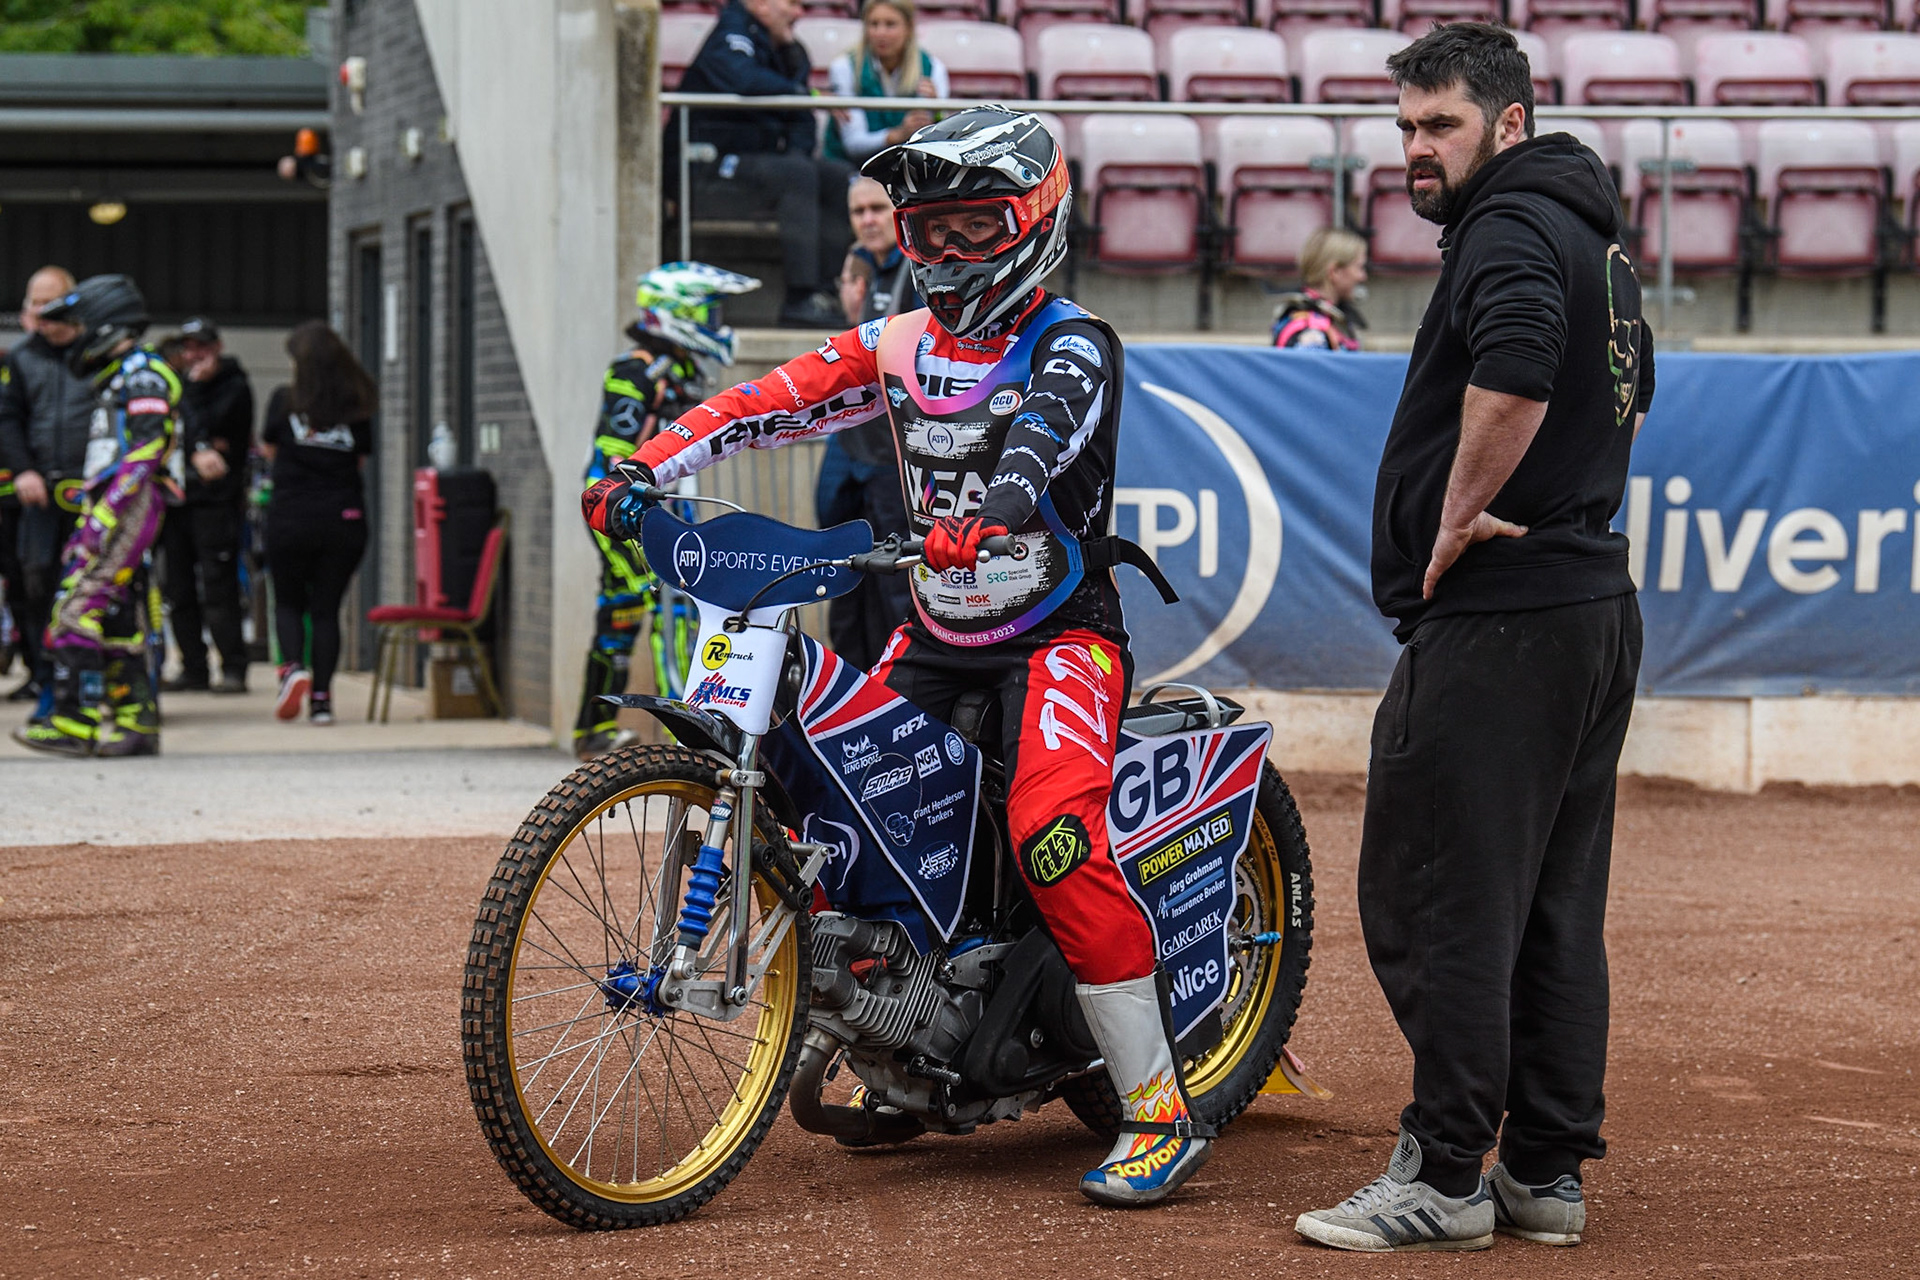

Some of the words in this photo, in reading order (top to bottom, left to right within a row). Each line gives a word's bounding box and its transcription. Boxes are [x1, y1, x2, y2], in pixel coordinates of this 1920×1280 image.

[992, 395, 1014, 406] ACU
[931, 434, 949, 445] ATPI
[678, 550, 700, 567] ATPI
[709, 550, 767, 571] SPORTS
[770, 553, 838, 577] EVENTS
[949, 571, 977, 585] GB
[986, 571, 1009, 584] SRG
[965, 594, 991, 604] NGK
[931, 624, 990, 644] MANCHESTER
[990, 624, 1016, 640] 2023
[706, 641, 754, 661] Rentruck
[710, 696, 747, 708] Racing
[891, 712, 929, 744] RFX
[918, 747, 939, 768] NGK
[1109, 738, 1191, 833] GB
[931, 789, 966, 811] Henderson
[926, 808, 954, 826] Tankers
[1141, 843, 1186, 880] POWER
[1183, 817, 1230, 855] MAXED
[1168, 880, 1186, 896] Jörg
[1184, 855, 1223, 885] Grohmann
[1171, 892, 1204, 919] Insurance
[1203, 878, 1227, 899] Broker
[1290, 871, 1302, 928] ANLAS
[1161, 908, 1223, 957] GARCAREK
[1171, 958, 1220, 1007] Nice
